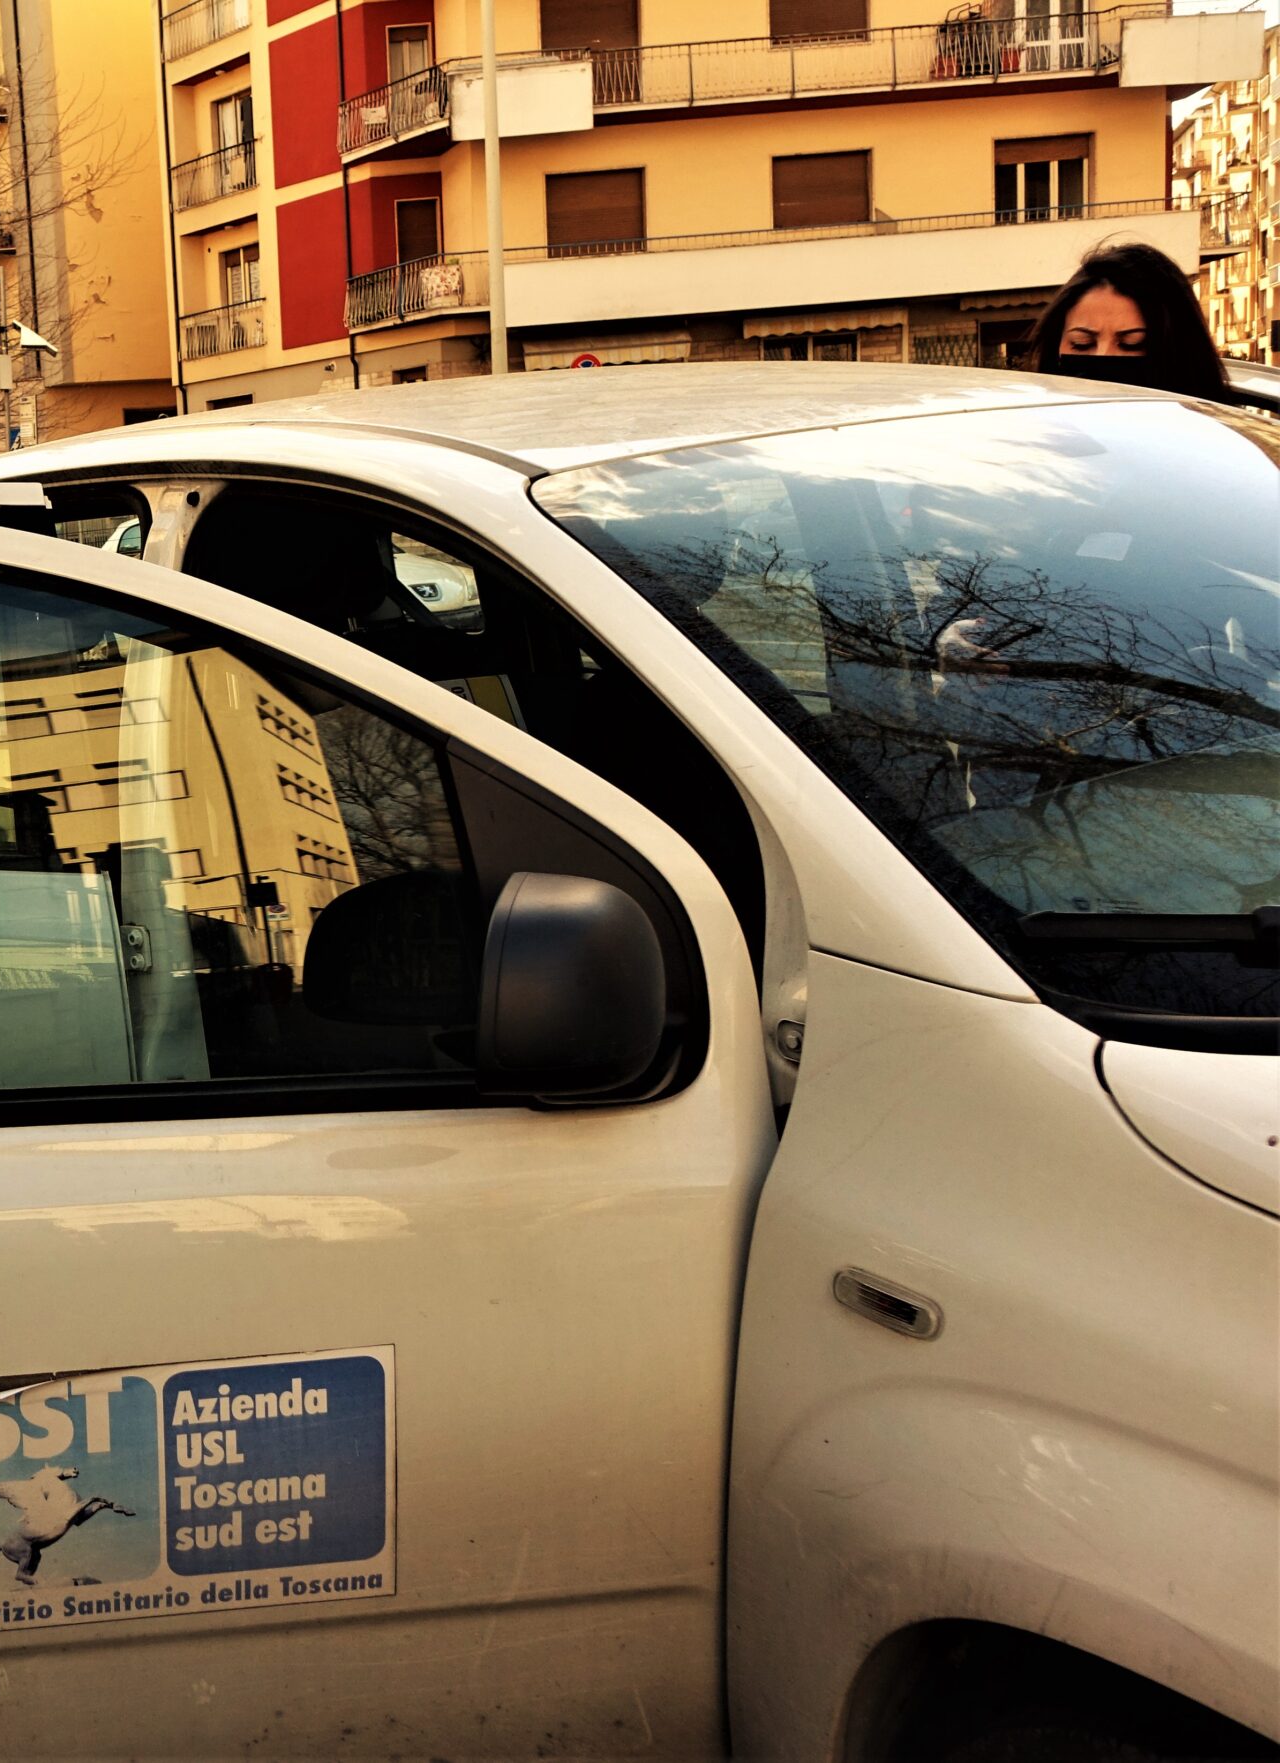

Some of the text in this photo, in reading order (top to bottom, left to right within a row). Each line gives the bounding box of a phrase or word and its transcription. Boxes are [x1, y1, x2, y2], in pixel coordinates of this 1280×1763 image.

[171, 1377, 328, 1427] Azienda
[176, 1429, 244, 1469] USL
[174, 1473, 326, 1511] Toscana
[175, 1510, 313, 1552] sud est
[63, 1586, 190, 1618] Sanitario
[200, 1579, 269, 1605] della
[279, 1572, 383, 1598] Toscana
